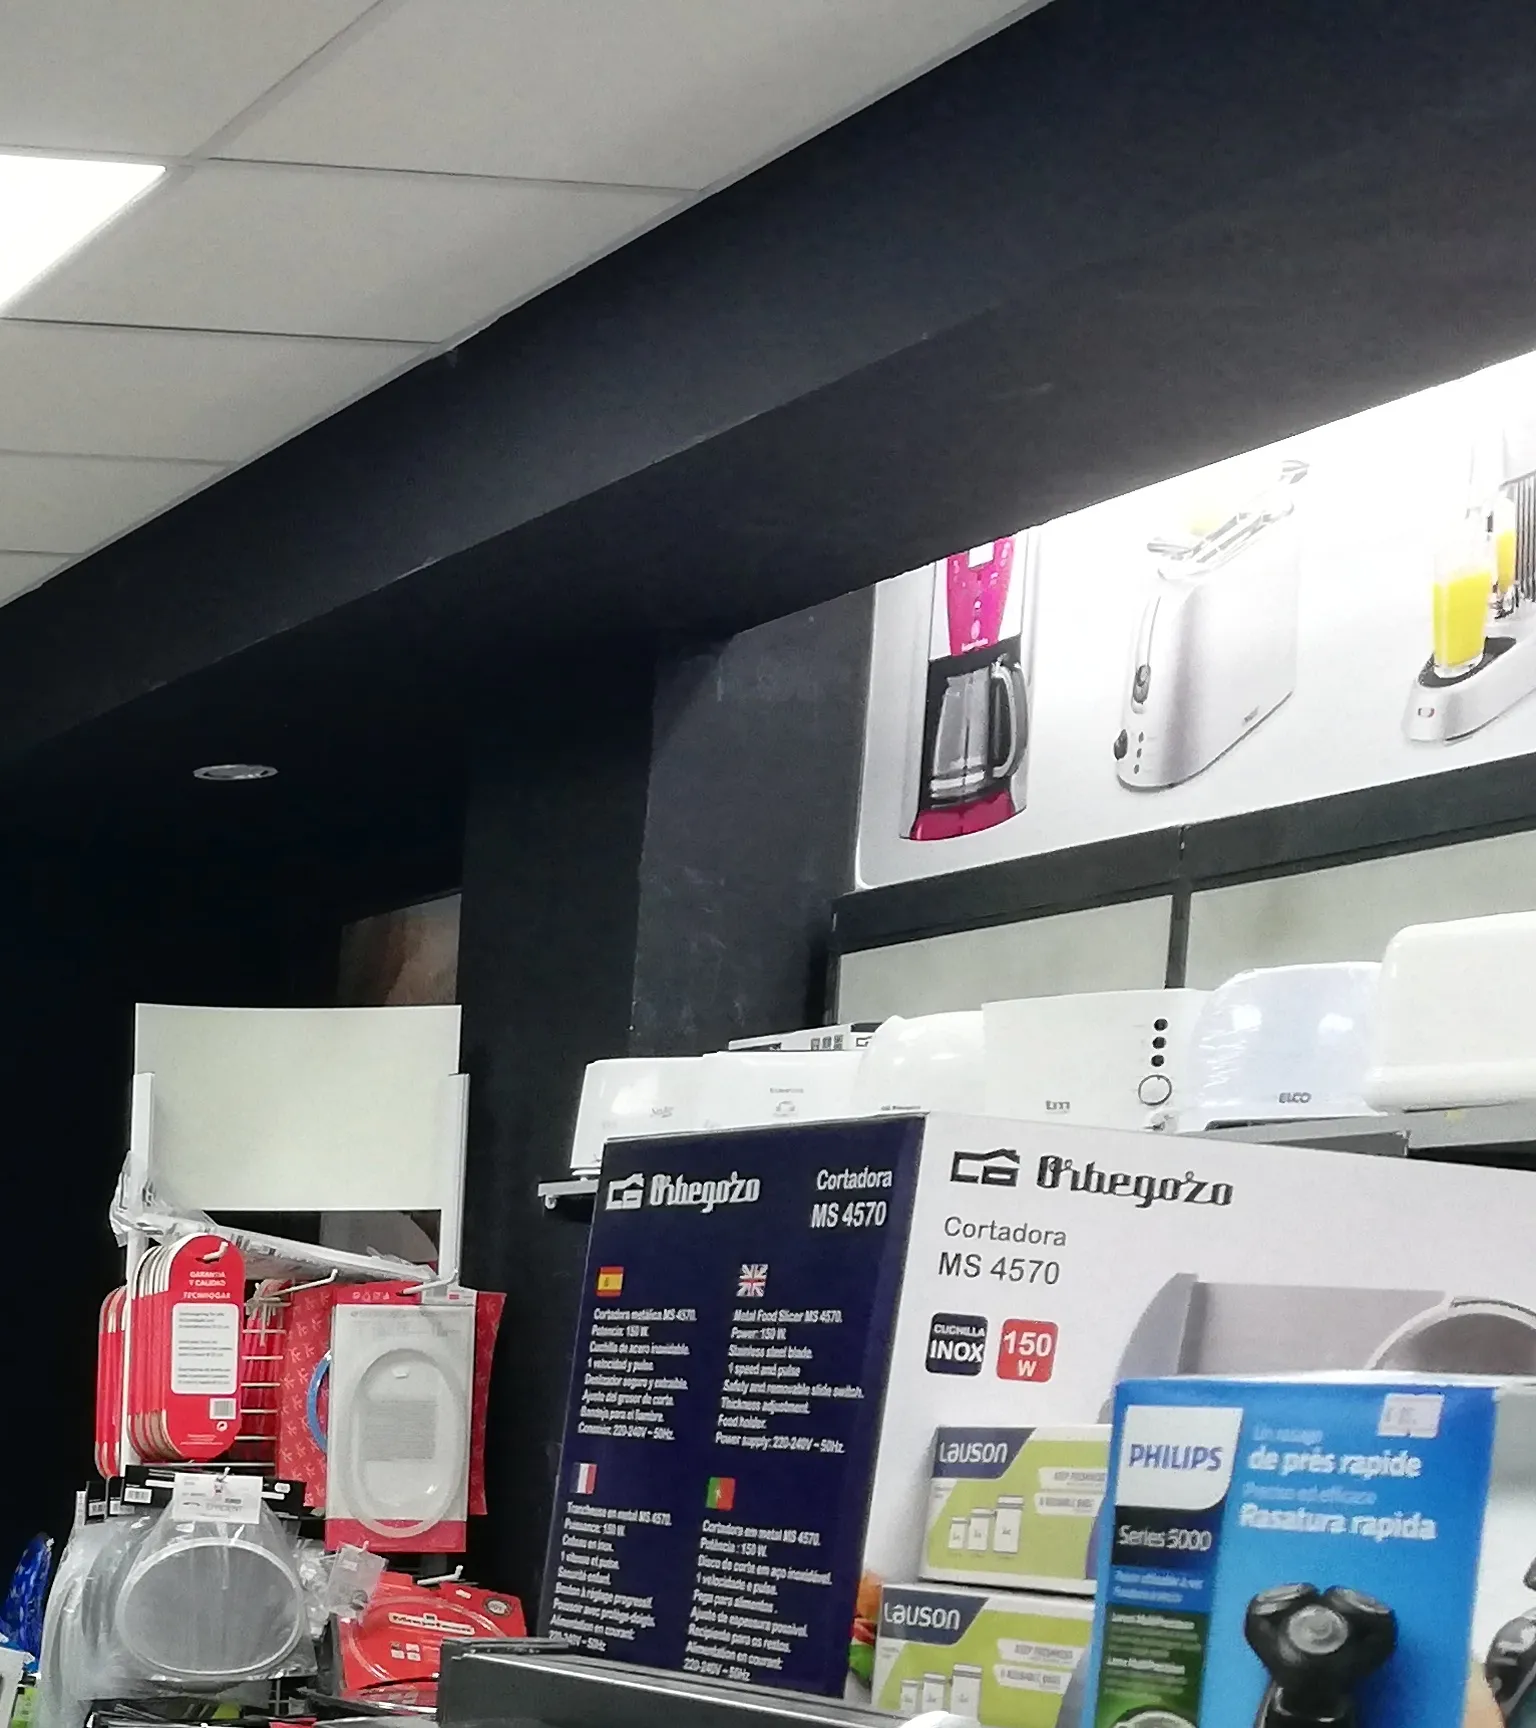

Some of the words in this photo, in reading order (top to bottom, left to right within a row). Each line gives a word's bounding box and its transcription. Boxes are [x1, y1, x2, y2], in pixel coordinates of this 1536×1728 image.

[816, 1167, 893, 1191] Cortadora
[811, 1202, 839, 1230] MS
[841, 1201, 888, 1228] 4570
[943, 1215, 1068, 1248] Cortadora
[938, 1252, 982, 1280] MS
[990, 1255, 1061, 1287] 4570
[933, 1323, 986, 1338] CUCHILLA
[1003, 1329, 1053, 1359] 150
[929, 1339, 985, 1365] INOX
[1017, 1359, 1037, 1380] W
[1128, 1442, 1224, 1473] PHILIPS
[1248, 1446, 1279, 1472] de
[1338, 1448, 1424, 1480] rapide
[1348, 1511, 1437, 1544] rapida
